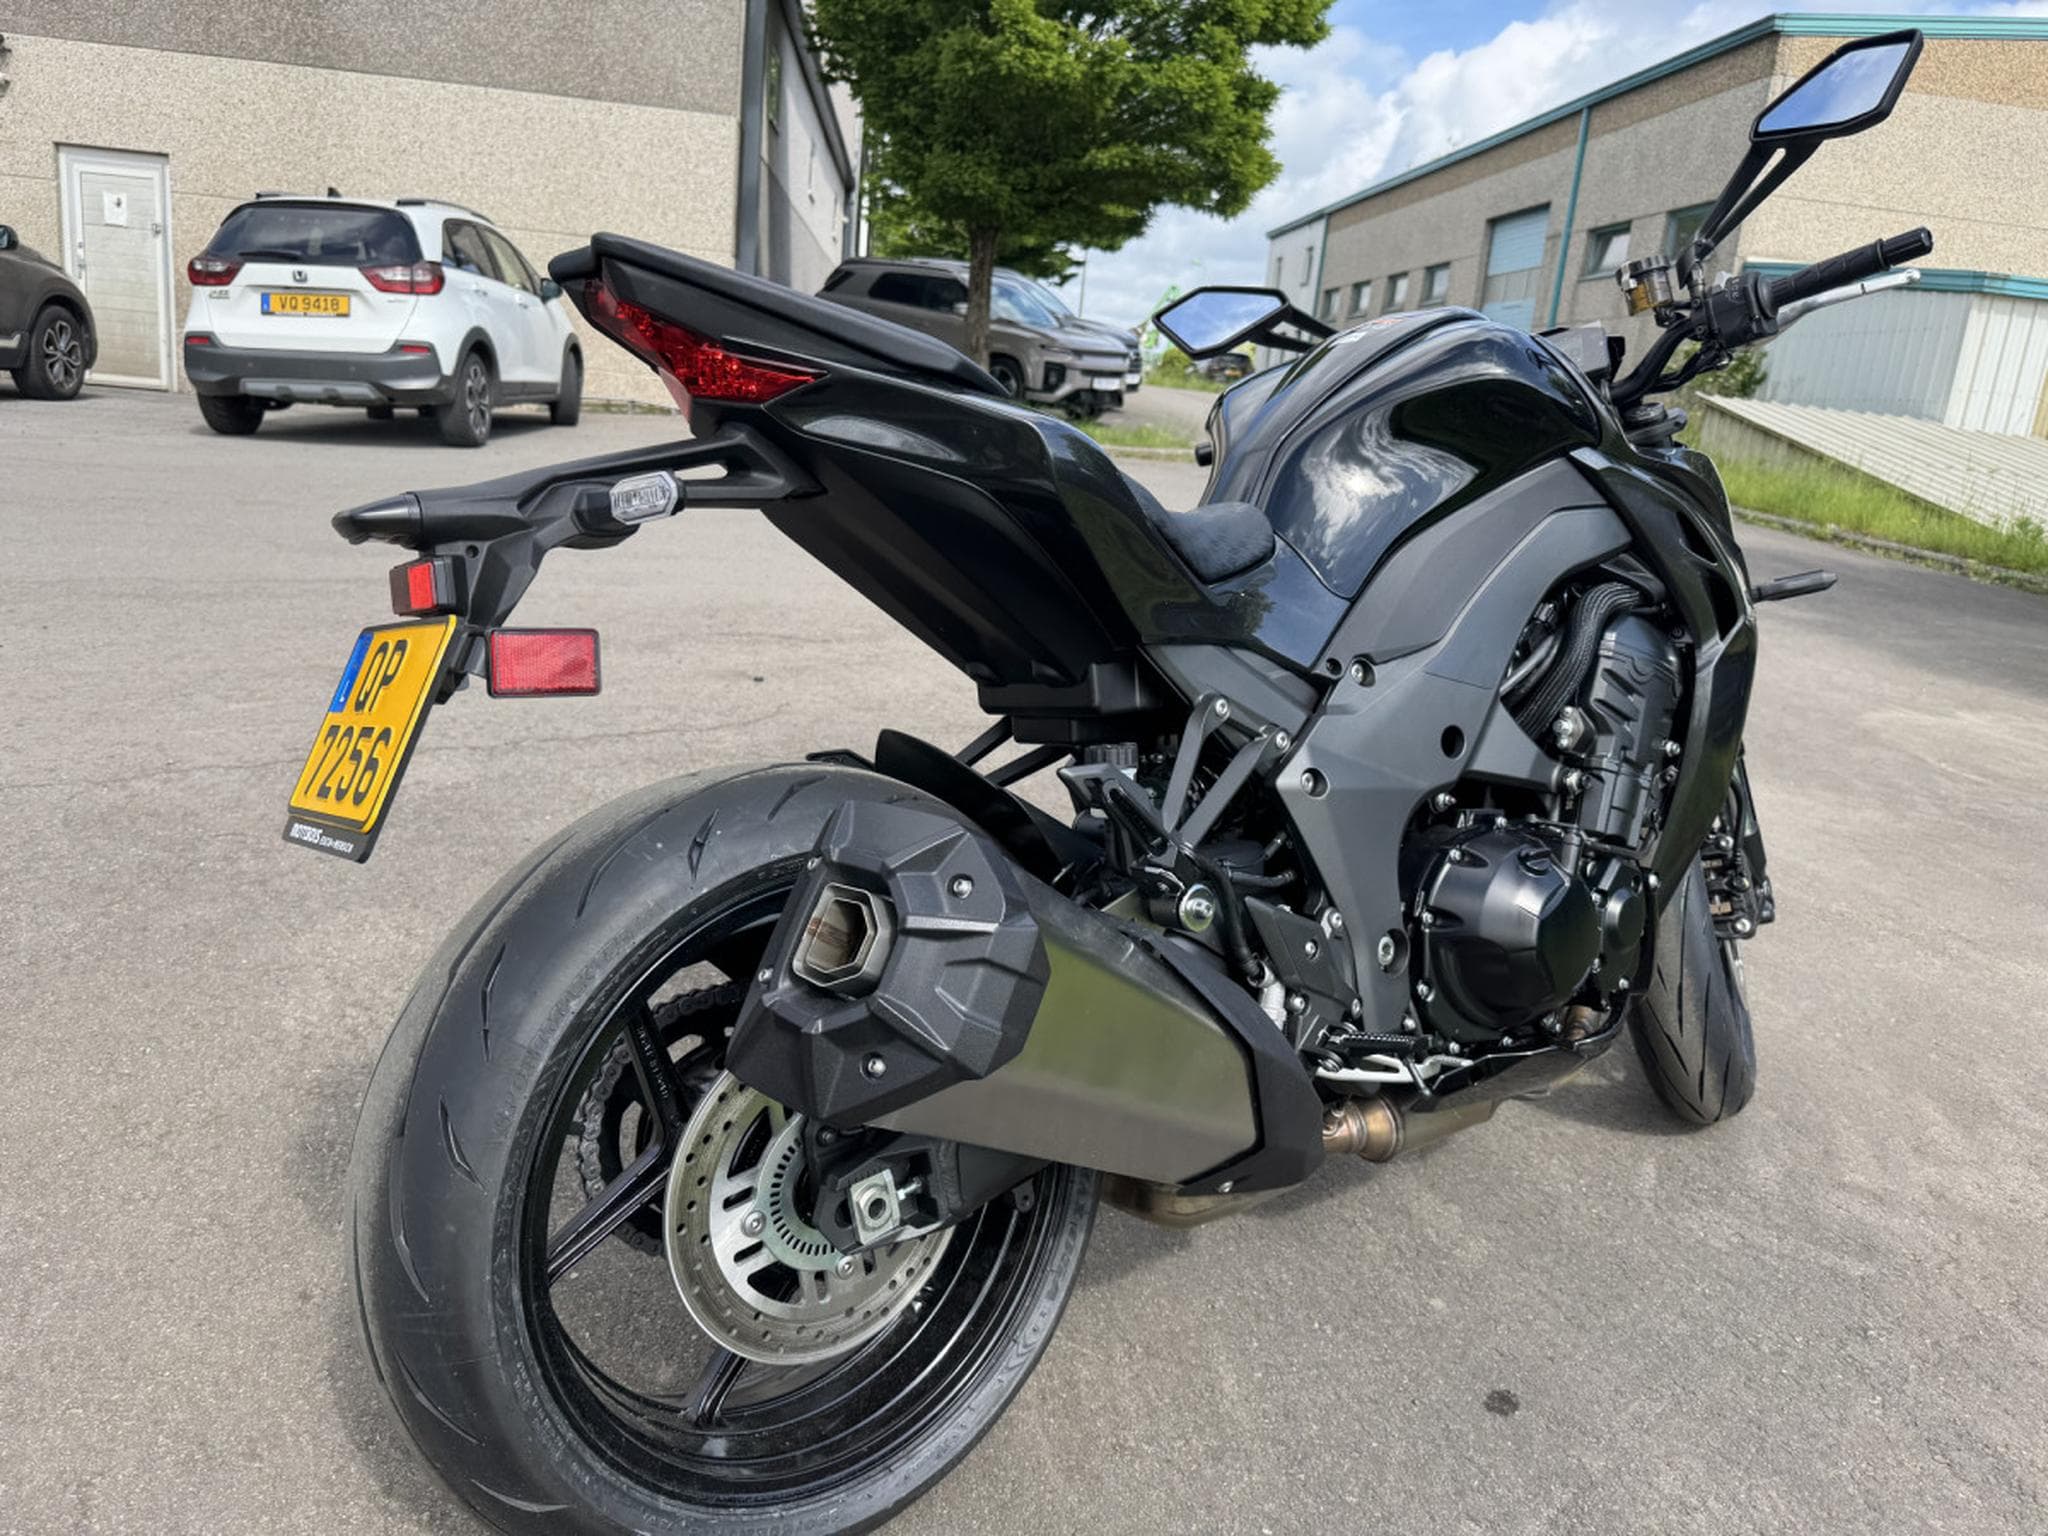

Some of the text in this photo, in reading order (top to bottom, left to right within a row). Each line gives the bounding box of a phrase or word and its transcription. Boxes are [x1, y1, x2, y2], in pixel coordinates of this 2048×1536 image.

[302, 297, 340, 311] 9418
[354, 639, 408, 712] QP
[304, 724, 392, 805] 7256
